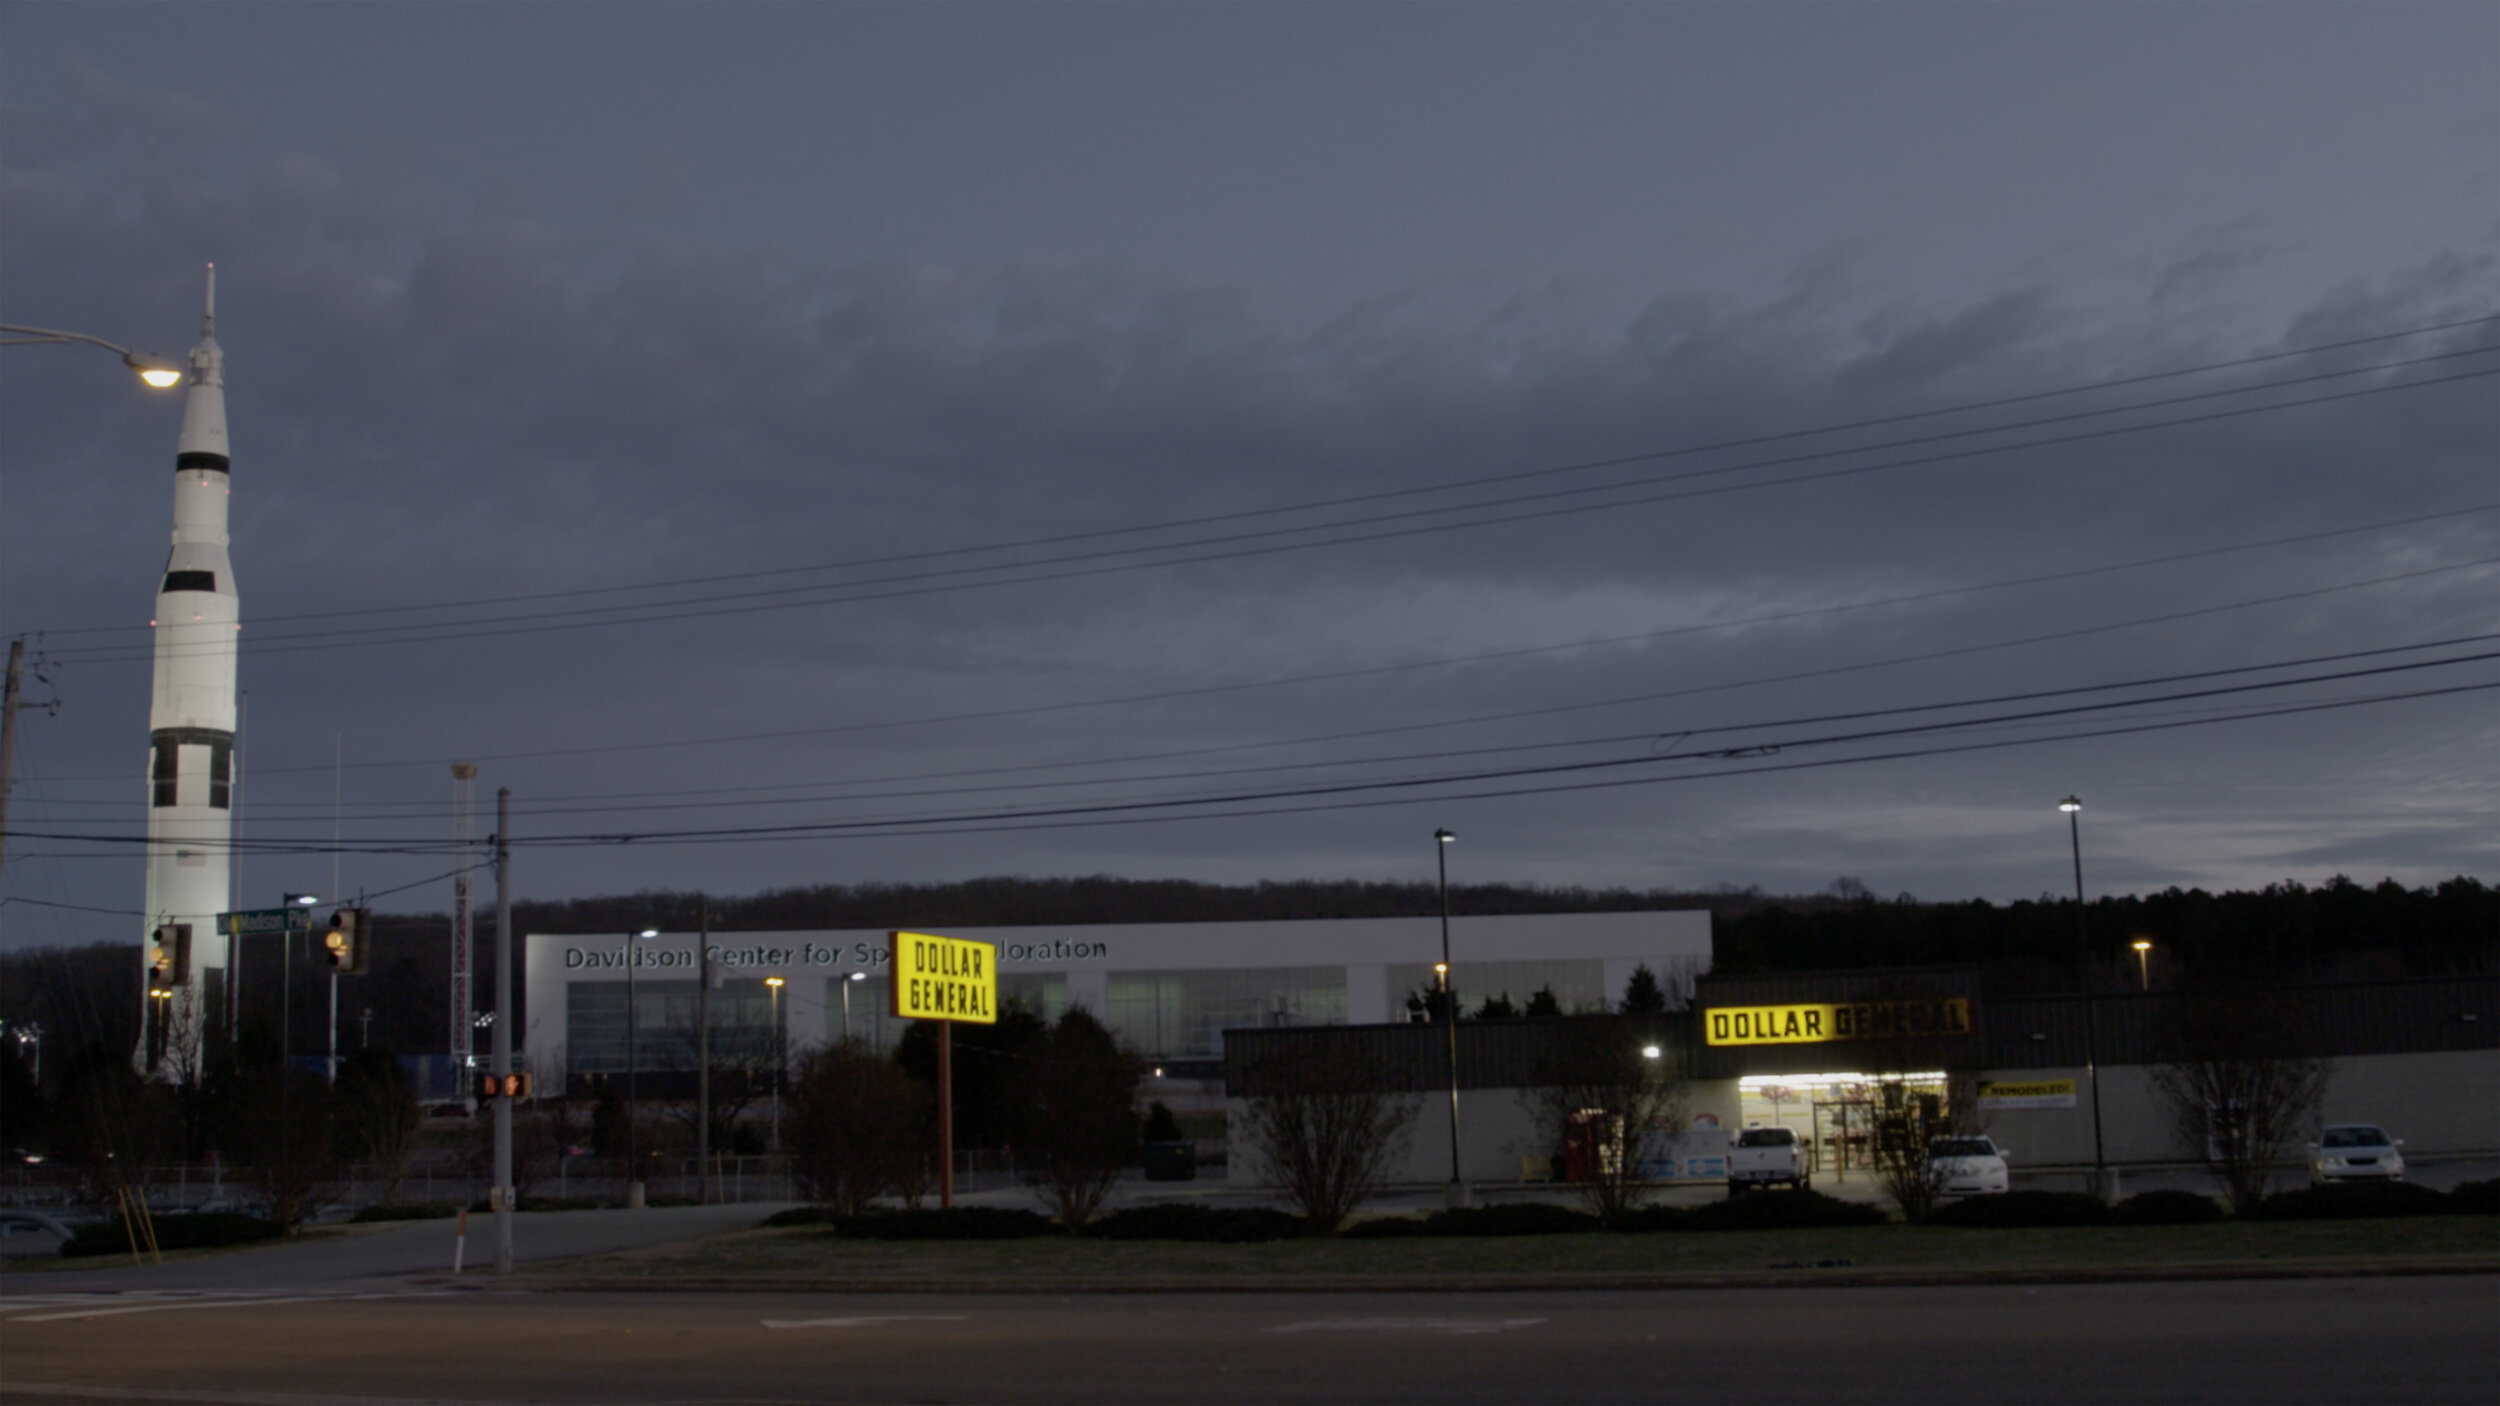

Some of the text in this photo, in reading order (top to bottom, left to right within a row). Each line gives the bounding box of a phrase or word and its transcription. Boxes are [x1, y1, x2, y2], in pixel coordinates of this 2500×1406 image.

[239, 912, 284, 931] Madison
[566, 946, 693, 968] Davidson
[804, 942, 843, 965] for
[999, 939, 1107, 961] loration
[915, 941, 983, 979] DOLLAR
[910, 978, 989, 1016] GENERAL
[1713, 1010, 1824, 1039] DOLLAR
